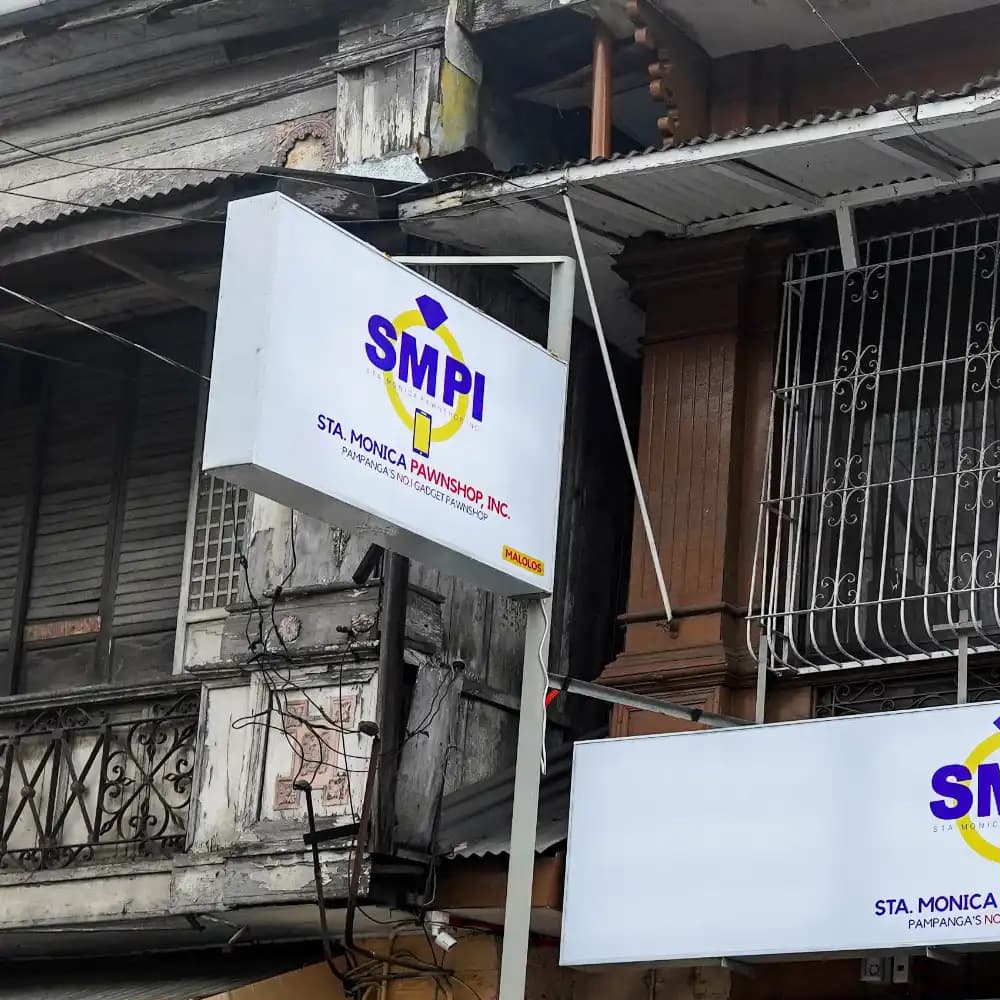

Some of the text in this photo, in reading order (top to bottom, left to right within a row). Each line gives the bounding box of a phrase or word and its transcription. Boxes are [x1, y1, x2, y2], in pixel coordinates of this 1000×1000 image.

[365, 314, 485, 422] SMPI
[318, 414, 510, 519] STA. MONICA PAWNSHOP, INC.
[342, 446, 395, 479] PAMPANGA'S
[414, 481, 445, 501] GADGET
[446, 496, 488, 520] PAWNSHOP
[506, 549, 542, 572] MALOLOS
[875, 899, 912, 916] STA.
[918, 893, 998, 913] MONICA
[908, 915, 982, 929] PAMPANGA'S
